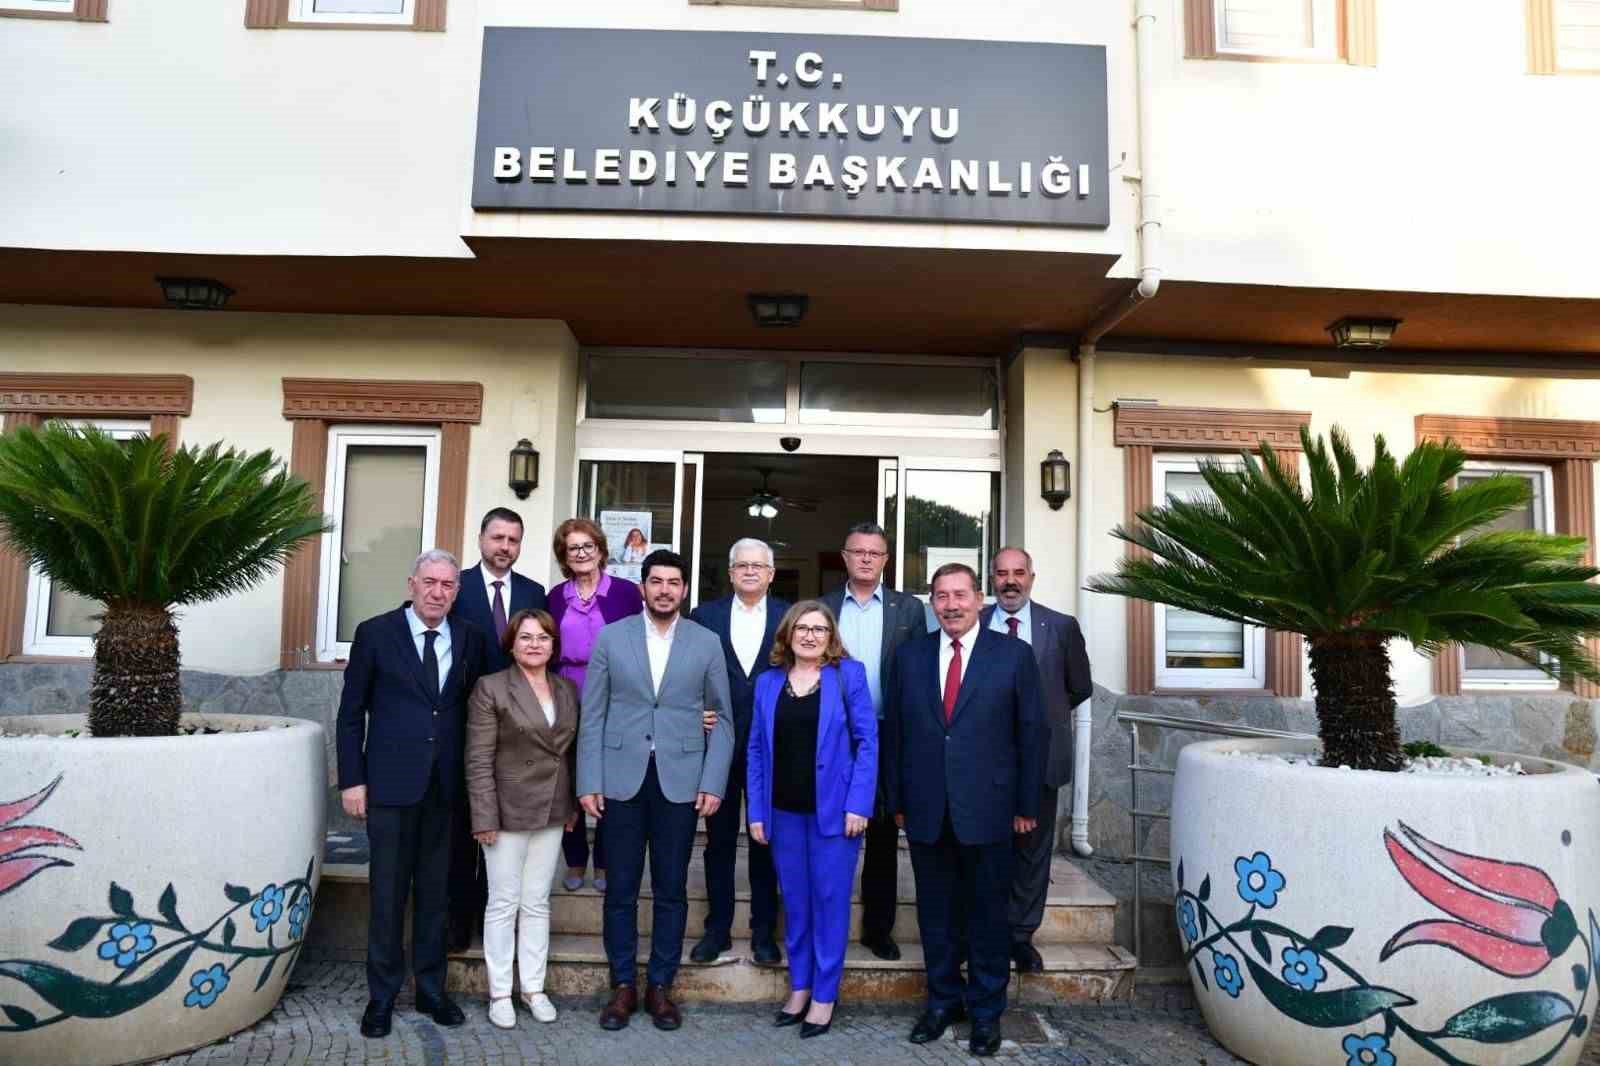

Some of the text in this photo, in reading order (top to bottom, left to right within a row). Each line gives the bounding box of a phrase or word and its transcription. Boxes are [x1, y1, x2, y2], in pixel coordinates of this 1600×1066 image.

[749, 50, 843, 85] T.C.
[629, 93, 960, 139] KÜÇÜKKUYU
[768, 152, 1090, 196] BAŞKANLIĞI
